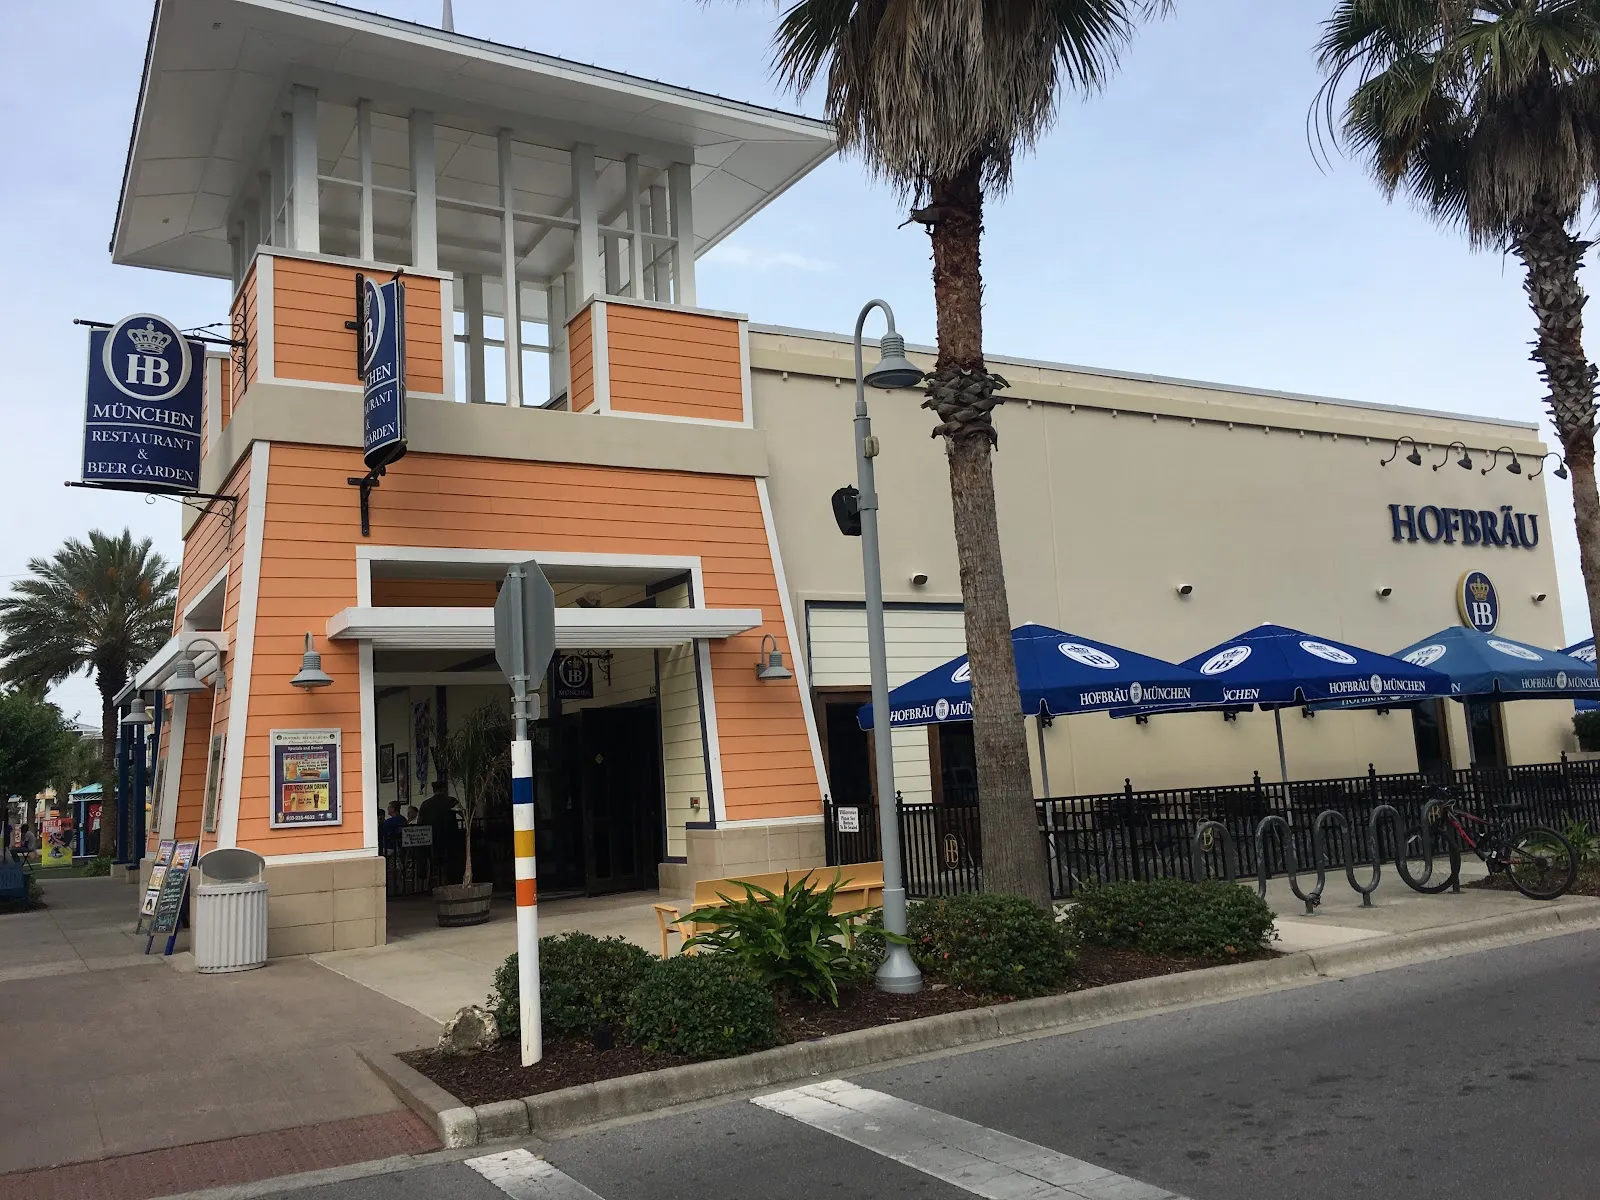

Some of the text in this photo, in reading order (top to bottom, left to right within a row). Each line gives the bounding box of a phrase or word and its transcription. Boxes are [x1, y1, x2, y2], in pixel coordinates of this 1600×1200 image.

[126, 354, 170, 387] HB
[92, 402, 195, 429] MÜNCHEN
[91, 430, 194, 451] RESTAURANT
[137, 448, 149, 460] &
[87, 461, 194, 482] BEER GARDEN
[1389, 503, 1539, 548] HOFBRÄU
[1472, 602, 1493, 626] HB
[568, 669, 583, 683] HB
[1328, 679, 1369, 694] HOFBRÄU
[1383, 678, 1426, 692] MÜNCHEN
[1521, 676, 1556, 689] HOFBRÄU
[1080, 687, 1129, 706] HOFBRÄU
[1143, 685, 1191, 701] MÜNCHEN
[890, 704, 934, 722] HOFBRÄU
